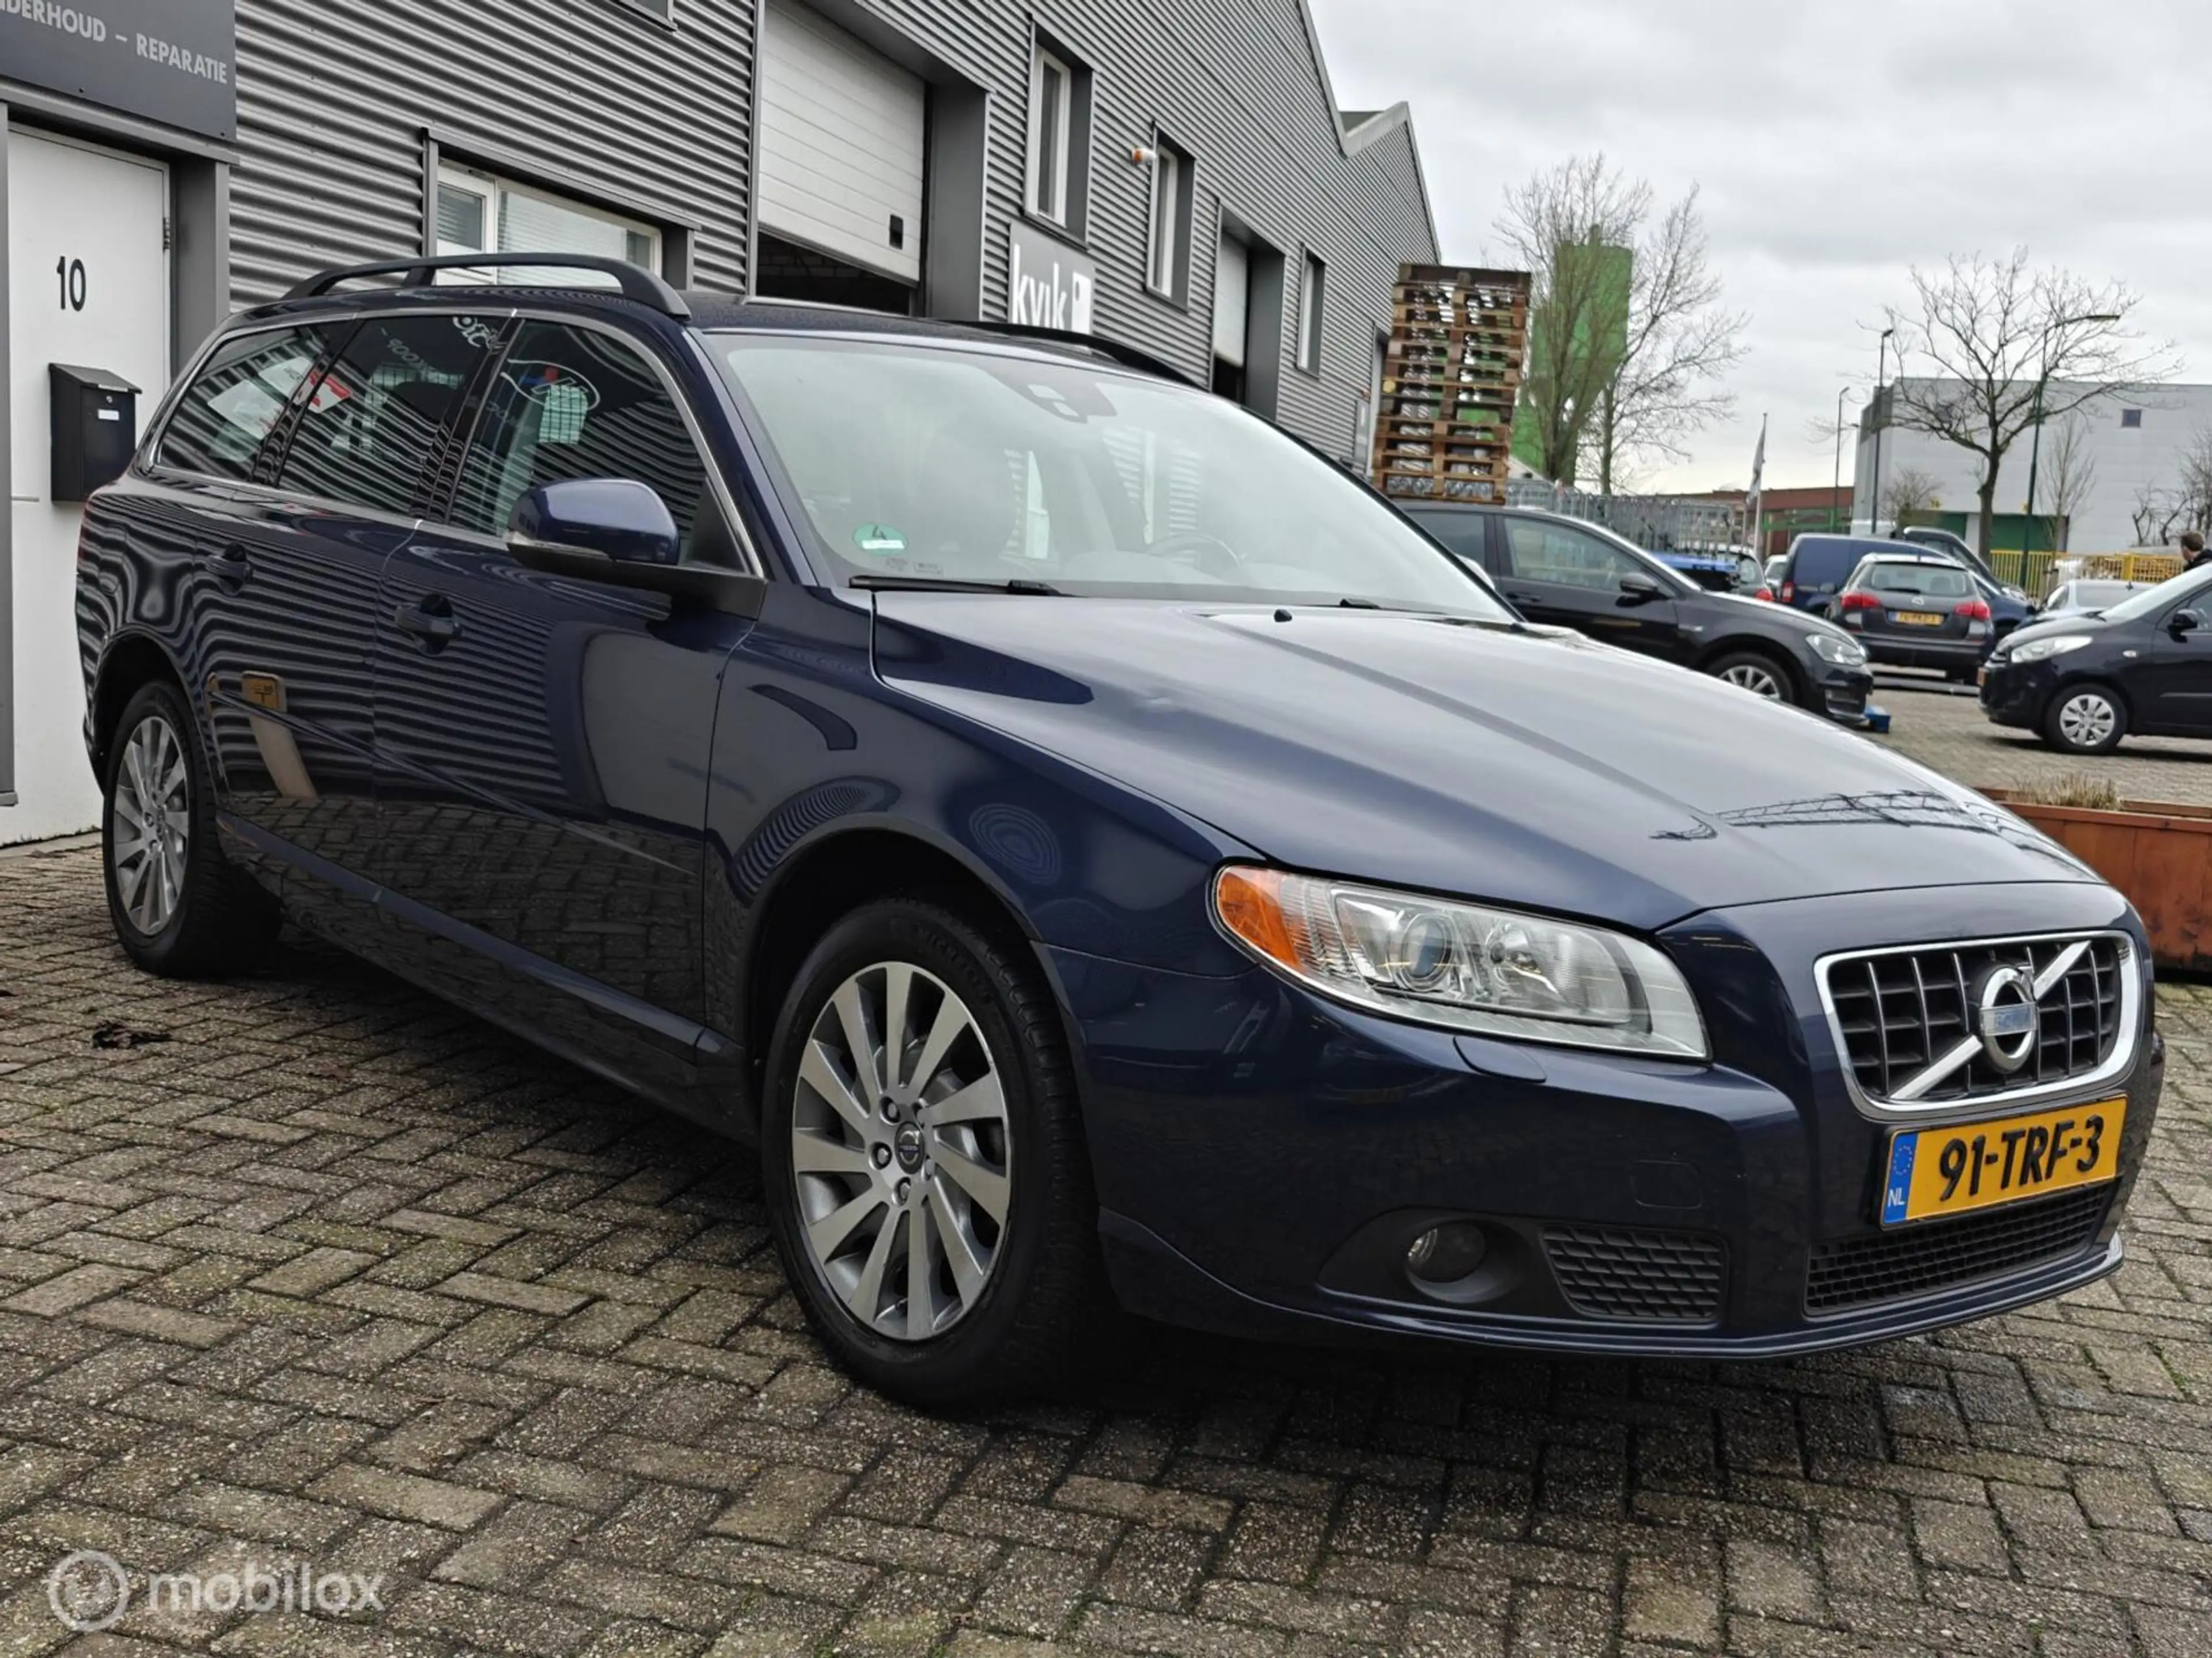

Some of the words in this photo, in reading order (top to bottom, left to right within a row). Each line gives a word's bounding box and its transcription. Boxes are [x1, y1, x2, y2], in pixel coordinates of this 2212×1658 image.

[0, 0, 106, 42] DERHOUD
[137, 33, 228, 84] REPARATIE
[56, 256, 86, 311] 10
[1012, 242, 1067, 331] kvik
[1887, 1188, 1905, 1206] NL
[1939, 1114, 2104, 1201] 91-TRF-3
